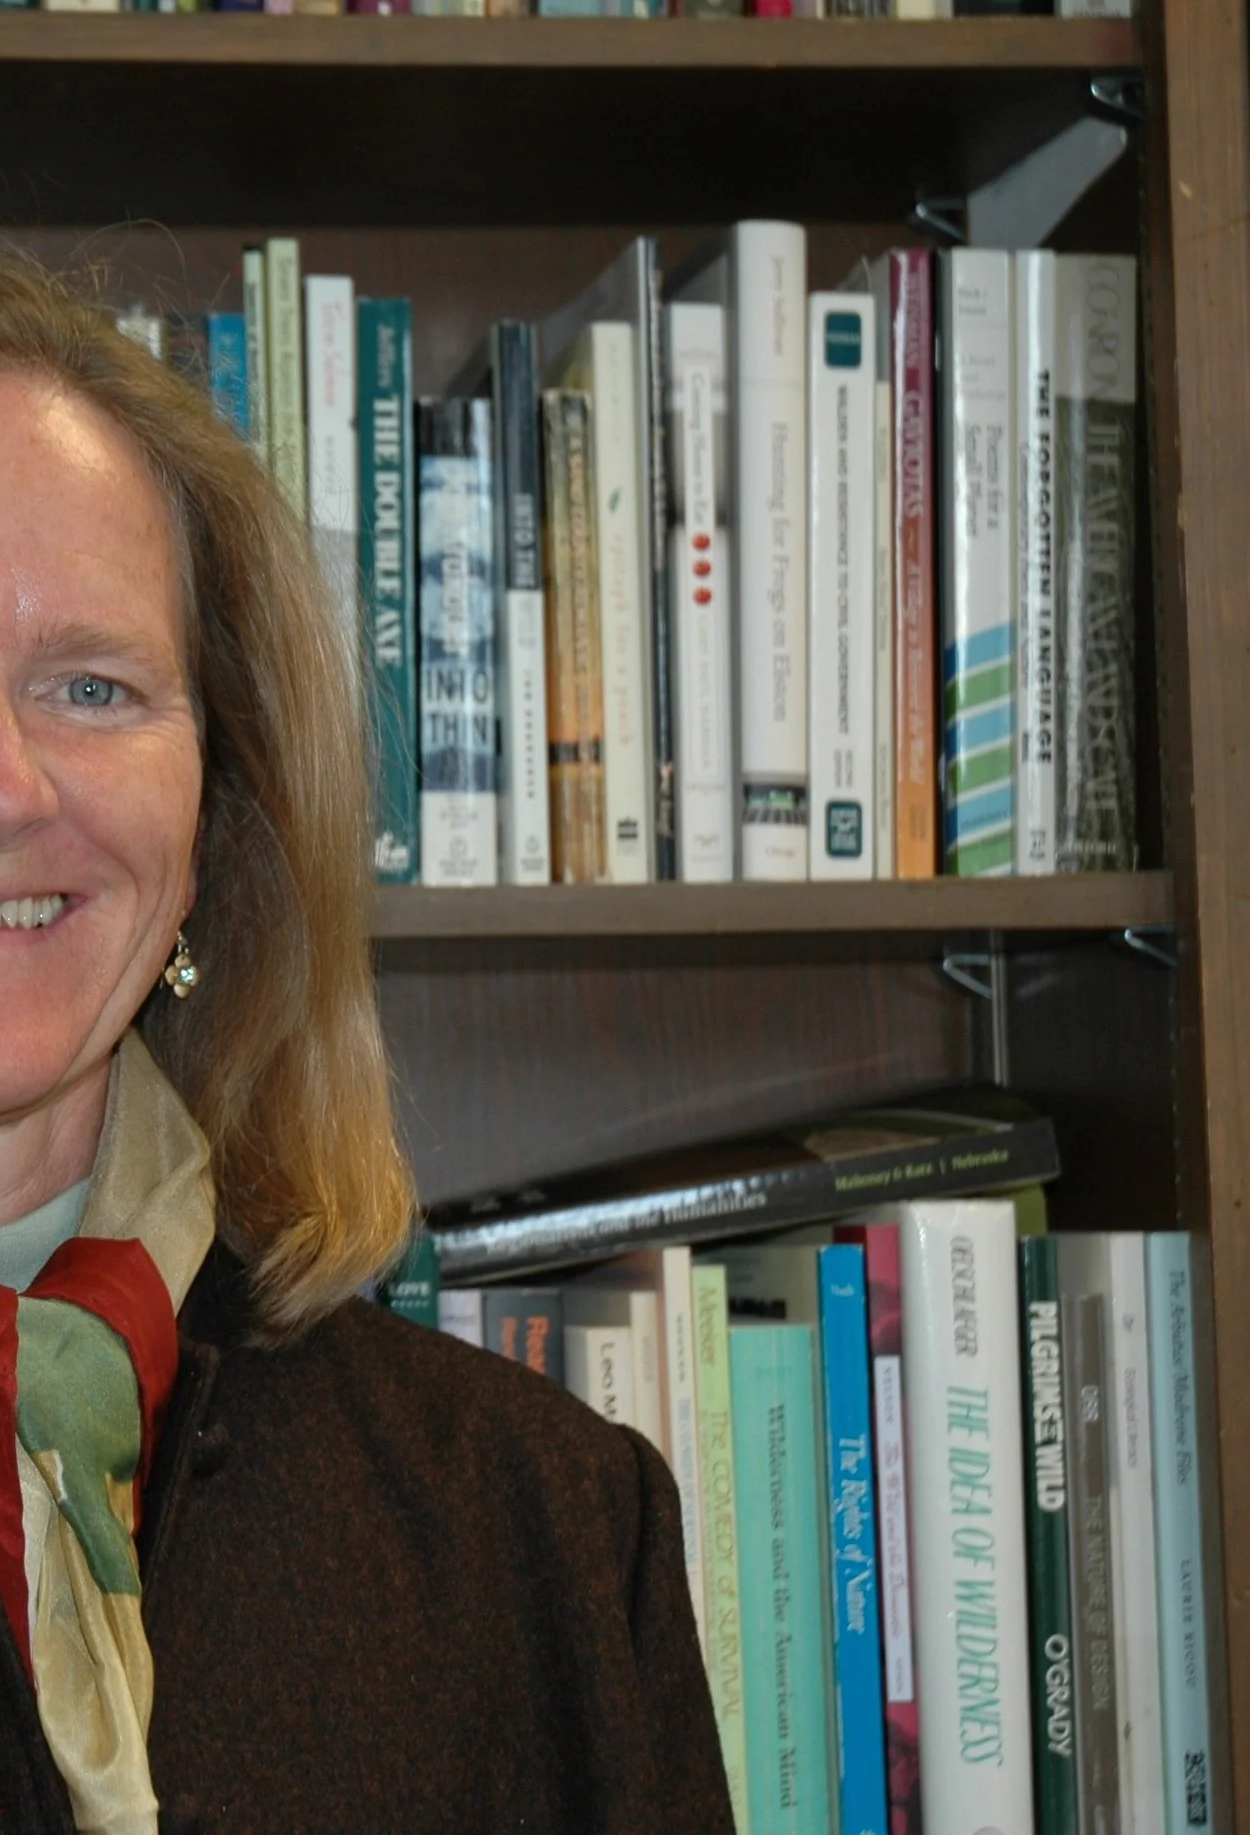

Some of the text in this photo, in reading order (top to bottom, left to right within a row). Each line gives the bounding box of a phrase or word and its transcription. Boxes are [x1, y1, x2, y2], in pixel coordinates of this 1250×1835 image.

[373, 393, 402, 465] THE
[902, 390, 926, 519] GAVIOTAS
[986, 425, 1004, 484] Poems
[1085, 418, 1121, 476] THE
[373, 470, 402, 600] DOUBLE
[766, 421, 792, 723] Hunting for Frogs on Elston
[1037, 370, 1053, 765] THE FORGOTTEN LANGUAGE
[374, 603, 403, 669] AXE
[835, 1167, 890, 1192] Mahoney
[951, 1147, 1010, 1171] Nebraska
[1168, 1270, 1187, 1298] The
[709, 1408, 729, 1450] The
[1028, 1301, 1067, 1513] PILGRIMS WILD
[712, 1458, 736, 1566] COMEDY
[830, 1434, 873, 1637] The Rights of Nature
[716, 1574, 739, 1599] of
[767, 1403, 800, 1810] Wilderness and the American Mind
[945, 1386, 1007, 1769] THE IDEA OF WILDERNESS
[1085, 1533, 1108, 1610] NATURE
[716, 1604, 743, 1724] SURVIVAL
[1043, 1633, 1074, 1759] O'GRADY
